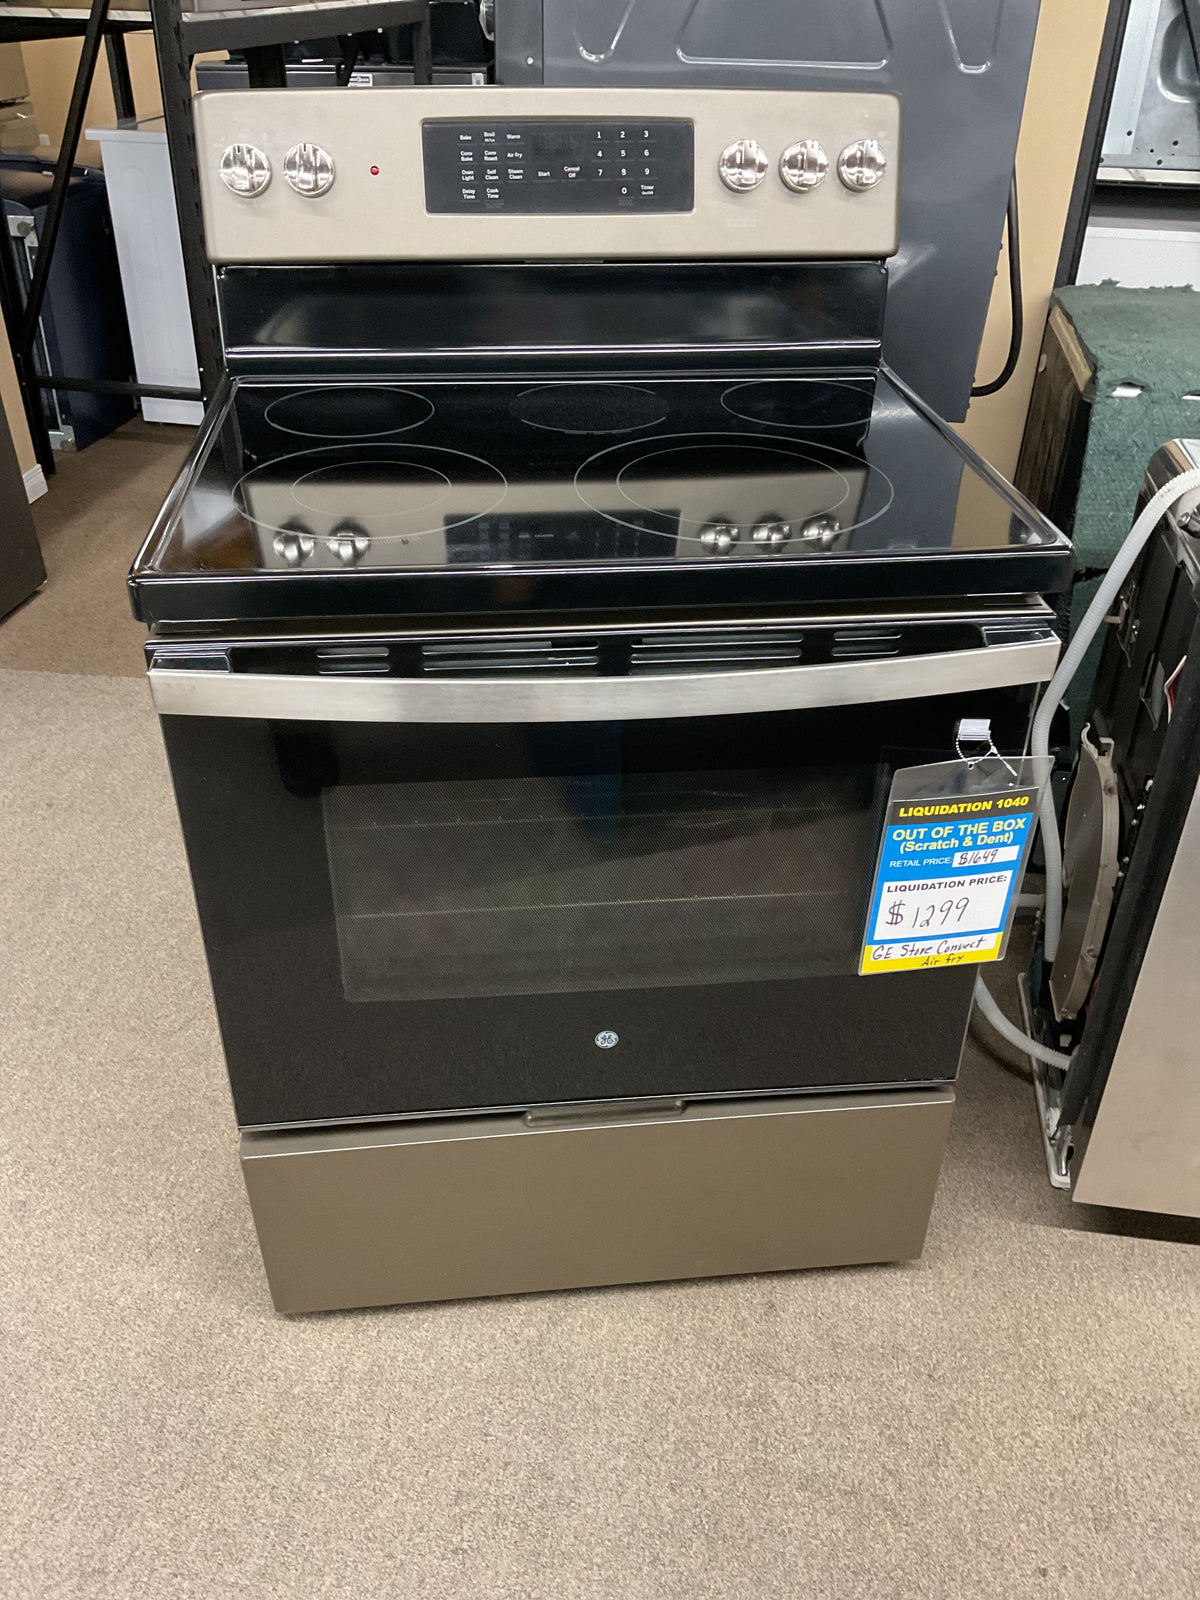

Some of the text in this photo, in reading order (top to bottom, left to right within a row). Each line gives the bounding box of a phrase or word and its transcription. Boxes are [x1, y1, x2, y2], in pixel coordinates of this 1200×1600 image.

[596, 131, 602, 139] 1
[620, 130, 626, 139] 2
[643, 130, 649, 138] 3
[596, 150, 603, 158] 4
[620, 149, 627, 157] 5
[643, 149, 650, 157] 6
[597, 168, 603, 176] 7
[621, 168, 627, 176] 8
[644, 167, 650, 175] 9
[621, 186, 628, 194] 0
[899, 796, 1029, 818] LIQUIDATION 1040
[892, 817, 1027, 841] OUT OF THE BOX
[899, 831, 1014, 855] (Scratch & Dent)
[889, 859, 921, 868] RETAIL
[957, 848, 999, 866] $1649
[886, 874, 1008, 893] LIQUIDATION PRICE:
[872, 945, 894, 961] GE
[920, 956, 941, 967] Air
